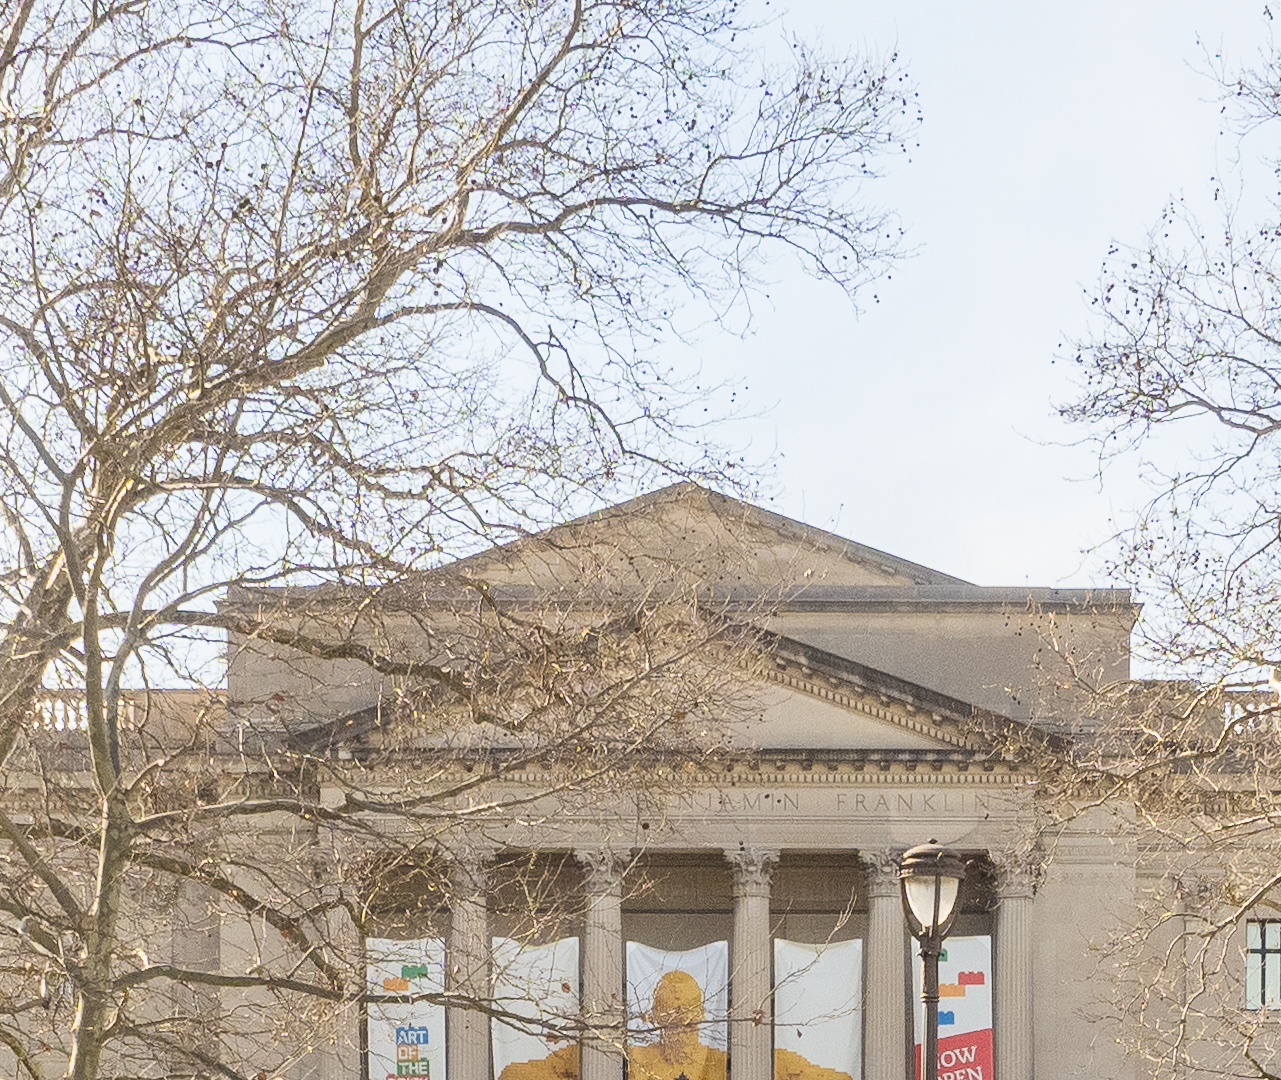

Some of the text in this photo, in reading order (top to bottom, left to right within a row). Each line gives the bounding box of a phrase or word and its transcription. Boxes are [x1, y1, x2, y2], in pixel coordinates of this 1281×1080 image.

[837, 793, 990, 812] FRANKLIN
[398, 1030, 427, 1045] ART
[398, 1046, 417, 1060] OF
[937, 1045, 977, 1069] OW
[398, 1062, 427, 1075] THE
